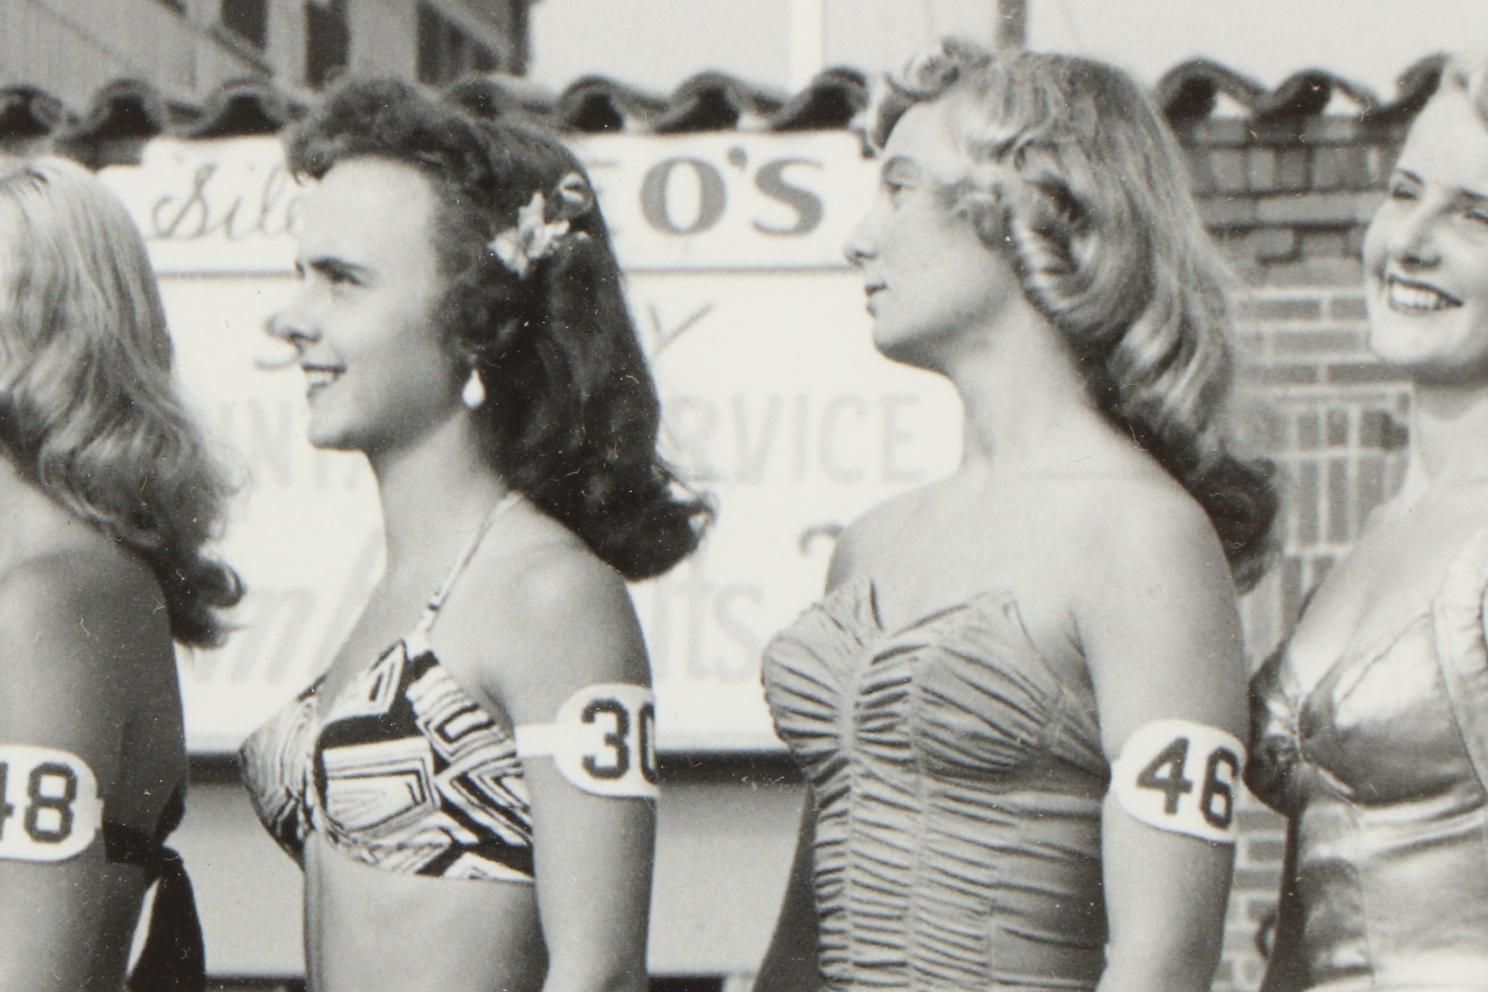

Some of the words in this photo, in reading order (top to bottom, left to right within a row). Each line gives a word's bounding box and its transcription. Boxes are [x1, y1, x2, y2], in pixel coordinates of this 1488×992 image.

[592, 145, 825, 237] O'S
[665, 394, 928, 485] RVICE
[1135, 736, 1239, 830] 46
